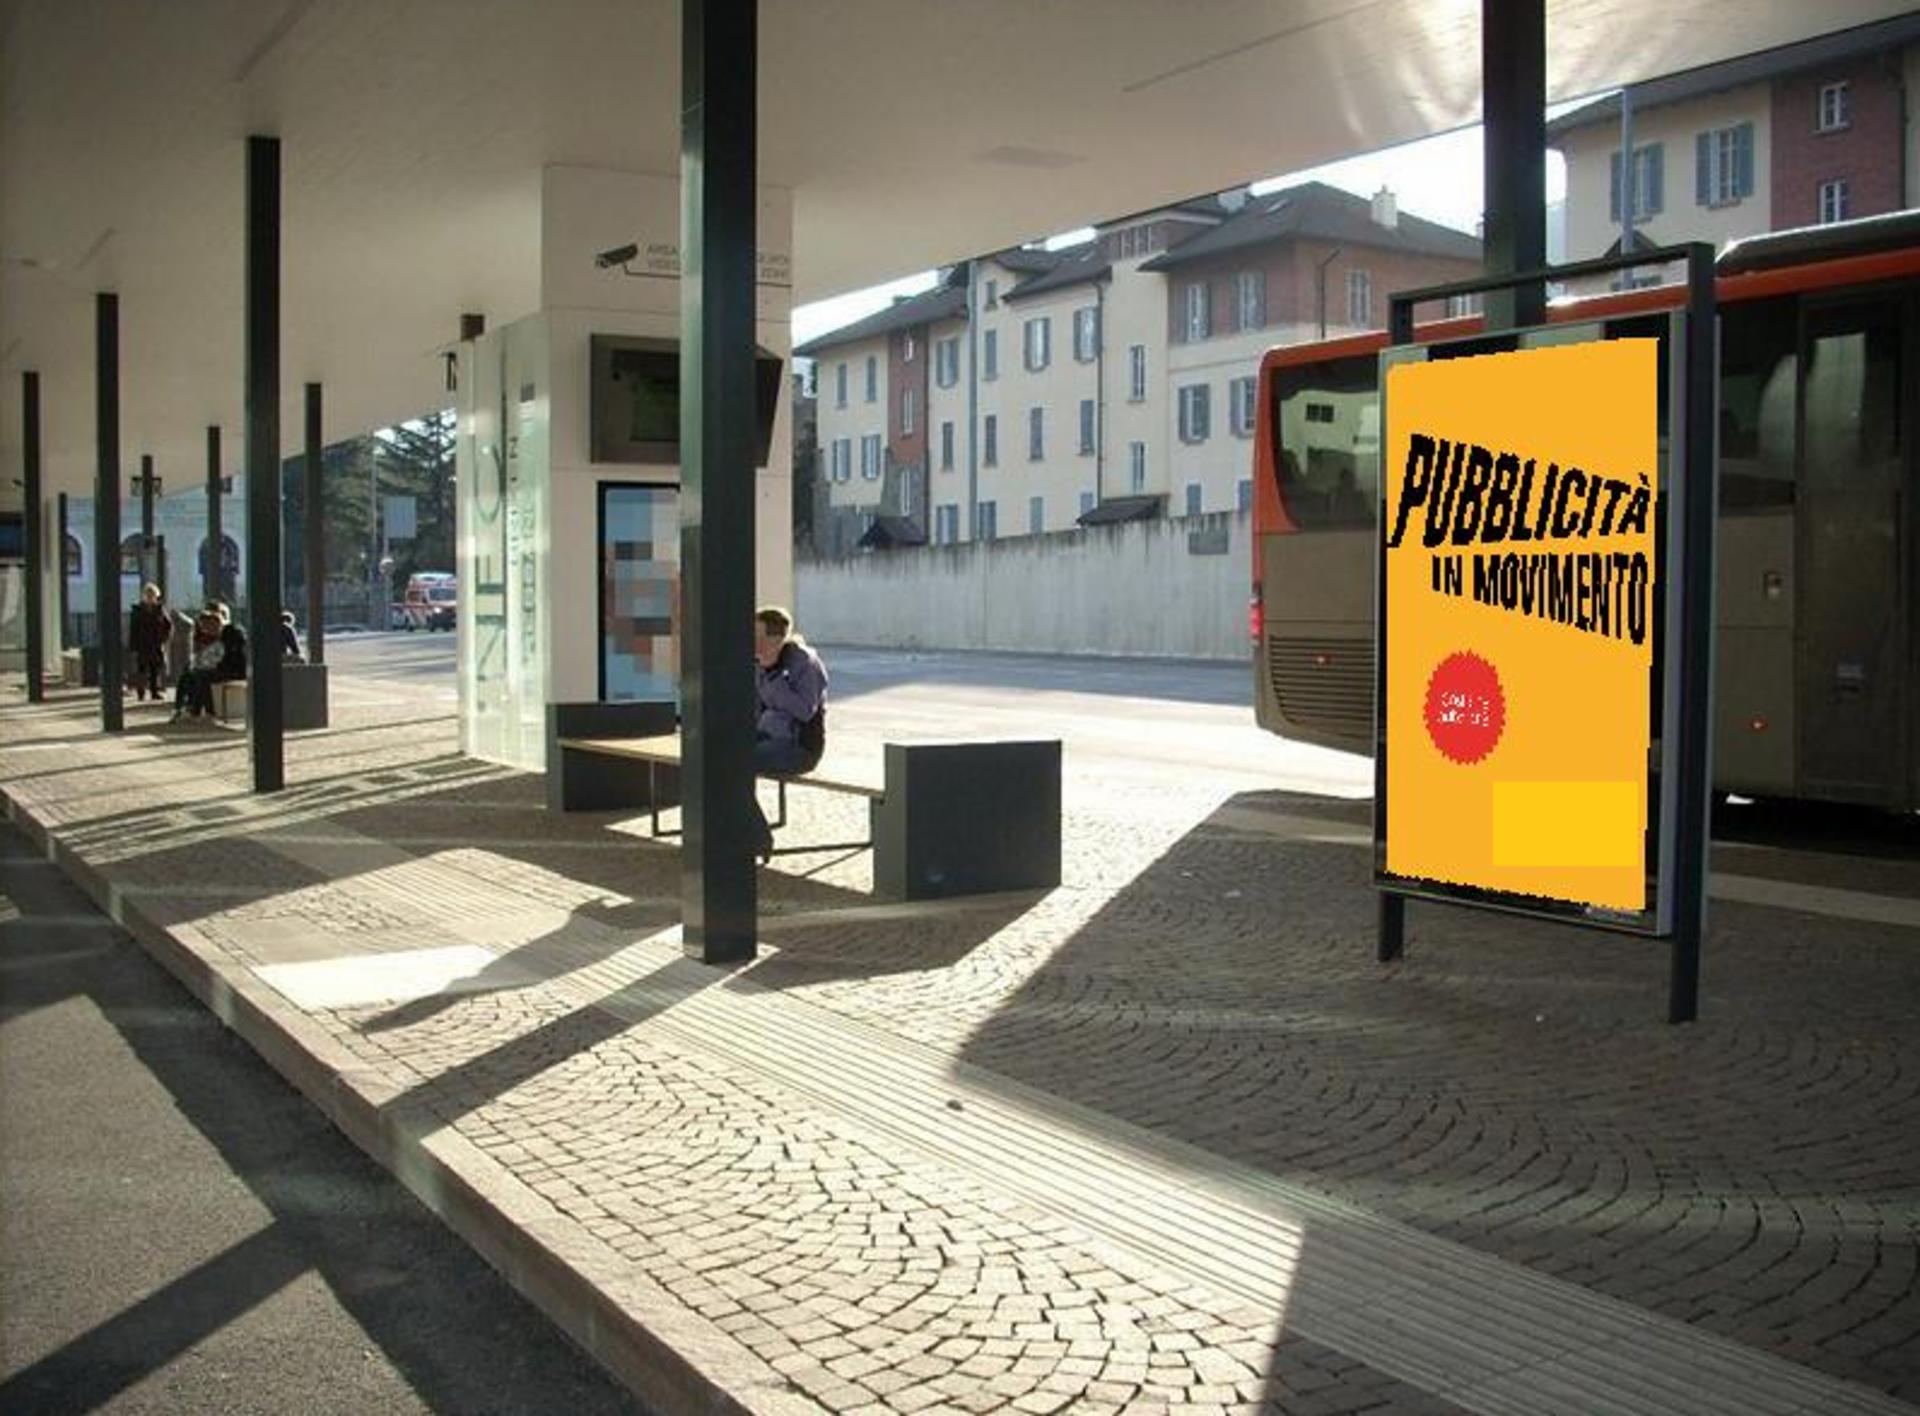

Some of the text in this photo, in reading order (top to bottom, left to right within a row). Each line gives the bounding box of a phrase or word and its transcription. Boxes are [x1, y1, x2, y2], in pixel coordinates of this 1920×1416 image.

[1387, 434, 1650, 548] PUBBLICITÀ
[1432, 552, 1648, 645] IN MOVIMENTO
